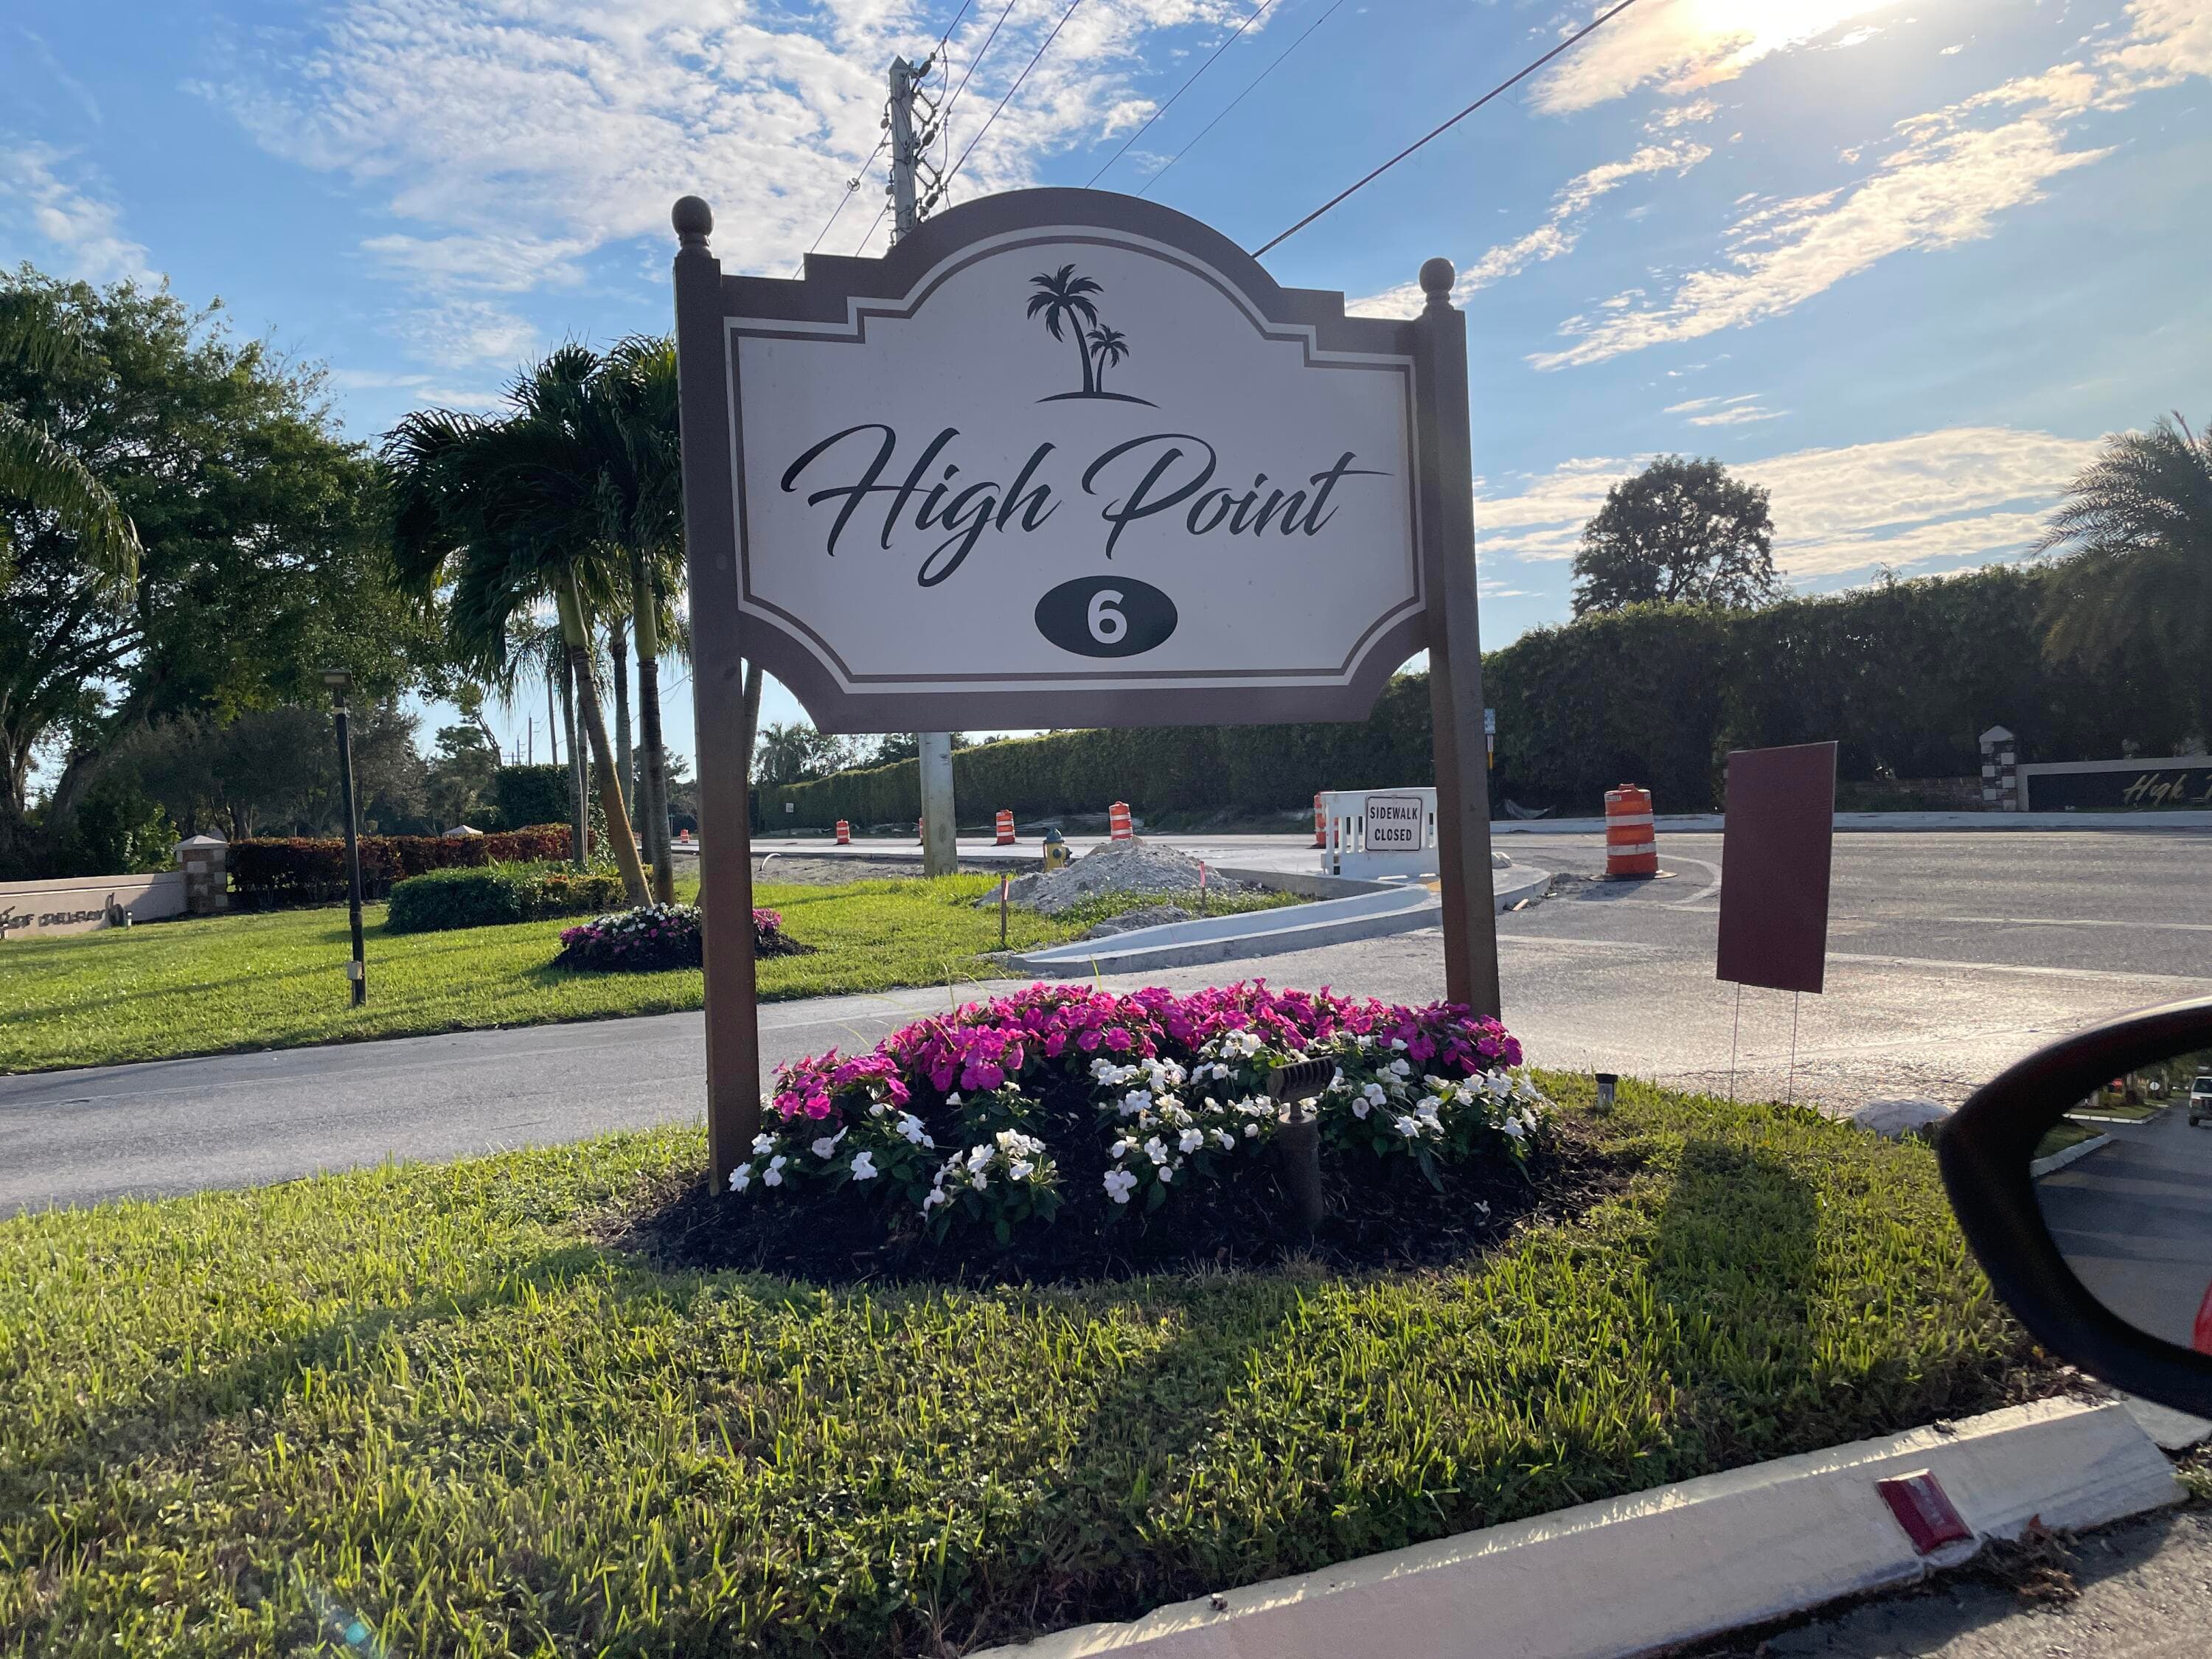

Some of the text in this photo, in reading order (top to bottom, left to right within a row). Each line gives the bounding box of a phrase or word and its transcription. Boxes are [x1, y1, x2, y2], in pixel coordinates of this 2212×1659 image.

[780, 423, 1395, 588] High Point
[1087, 590, 1128, 644] 6
[1370, 807, 1418, 820] SIDEWALK
[1374, 828, 1412, 841] CLOSED
